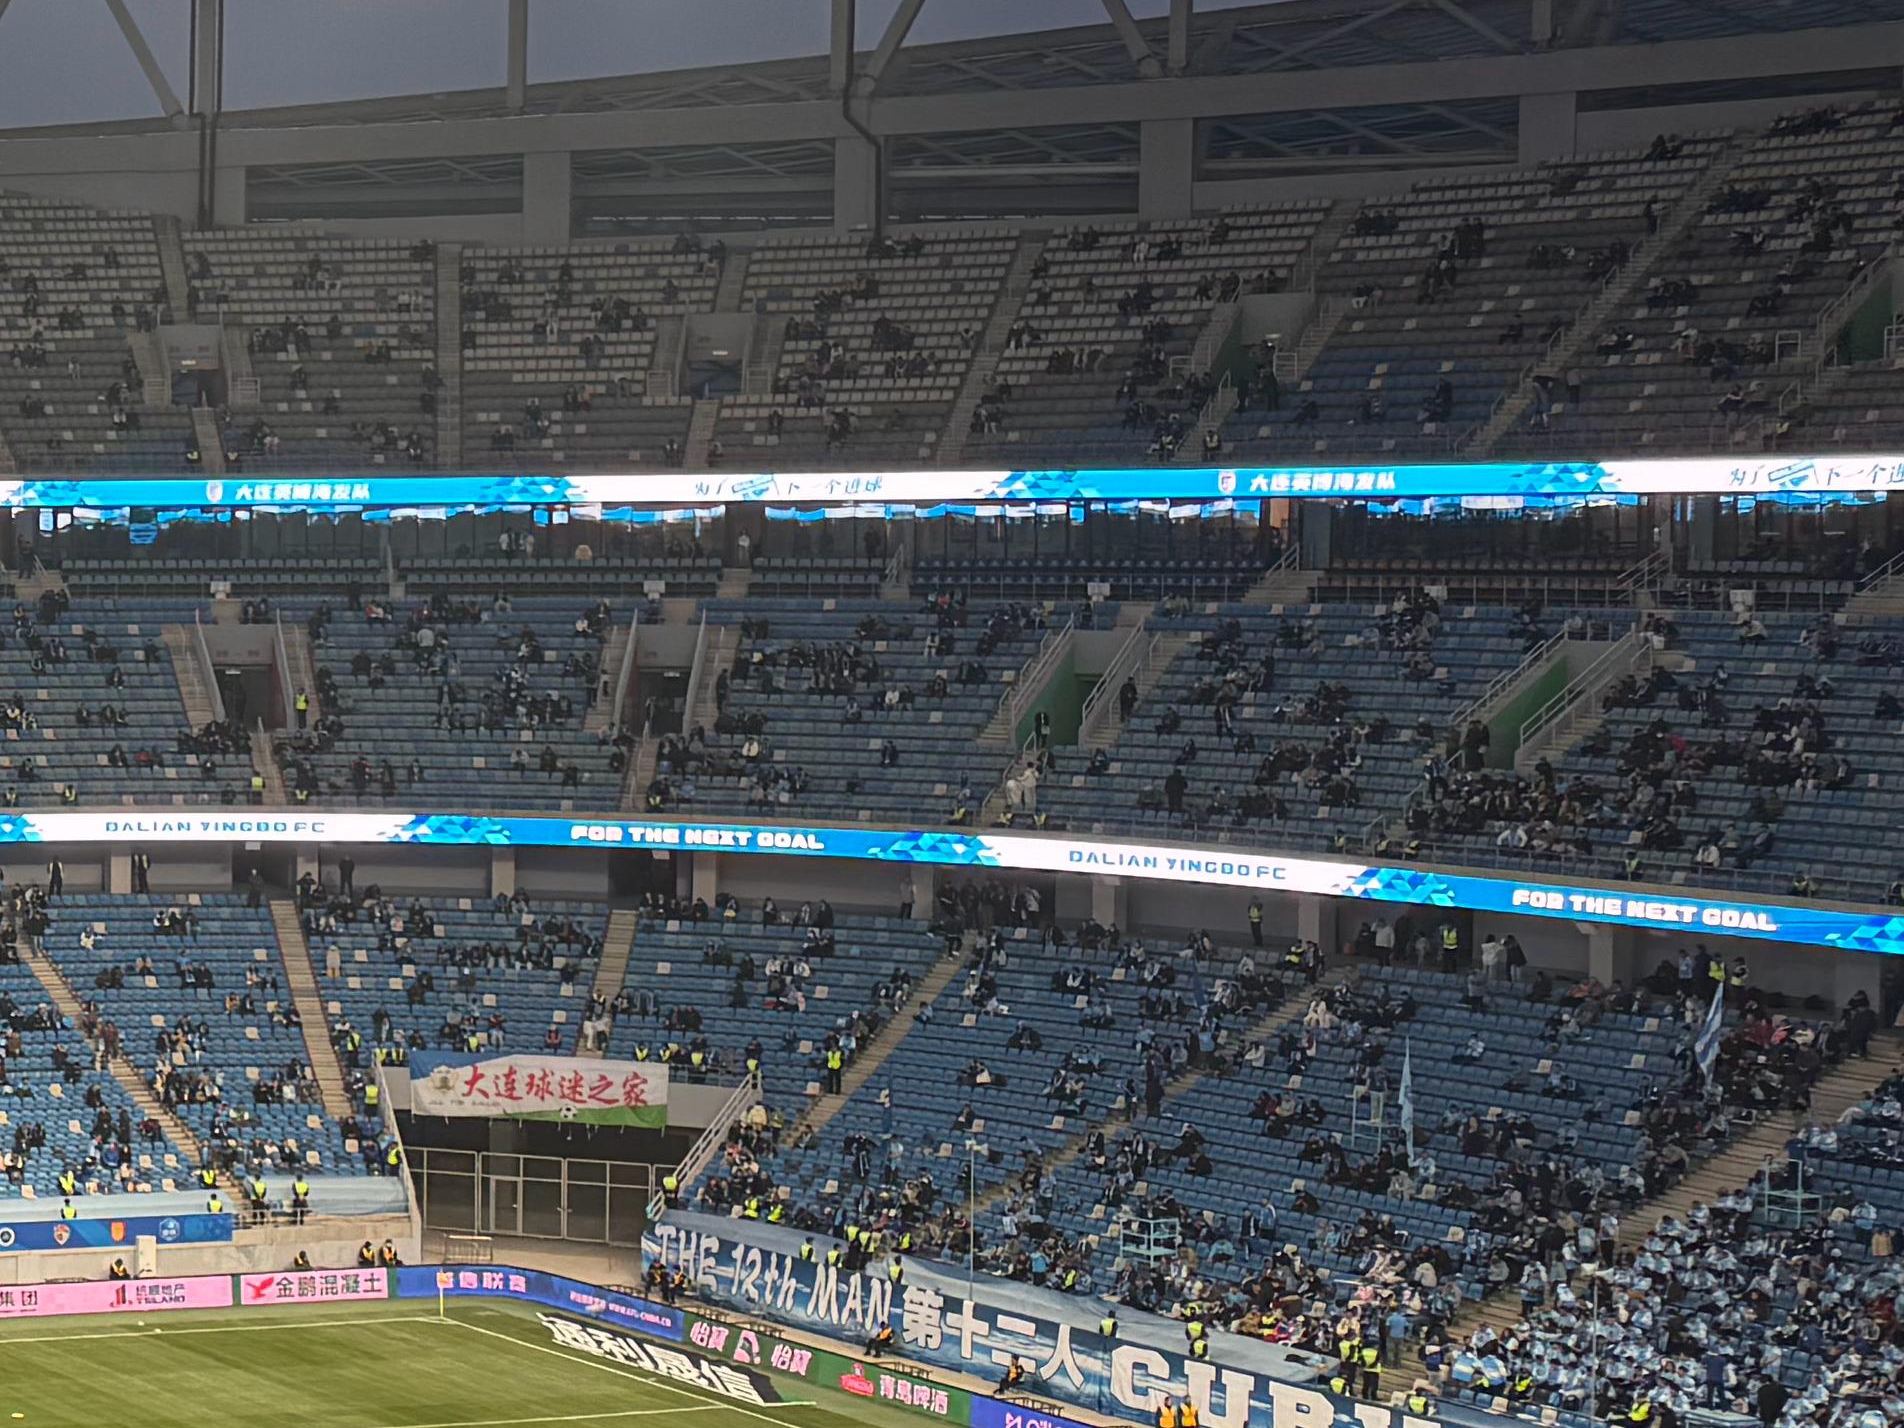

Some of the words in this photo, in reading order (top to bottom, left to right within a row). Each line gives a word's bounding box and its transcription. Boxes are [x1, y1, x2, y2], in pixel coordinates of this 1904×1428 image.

[105, 820, 192, 833] DALIAN
[294, 820, 326, 833] FC
[570, 825, 623, 842] FOR
[628, 826, 681, 844] THE
[685, 828, 753, 847] NEXT
[757, 831, 825, 850] GOAL
[1069, 849, 1158, 869] DALIAN
[1255, 865, 1288, 881] FC
[1512, 888, 1564, 910] FOR
[1568, 893, 1622, 916] THE
[1626, 900, 1698, 924] NEXT
[1702, 906, 1778, 932] GOAL
[462, 1065, 649, 1108] 大连球迷之家
[275, 1272, 383, 1299] 金鹏混凝土
[654, 1222, 719, 1295] THE
[731, 1241, 797, 1311] 12th
[806, 1266, 895, 1330] MAN
[901, 1283, 1086, 1388] 第十二人
